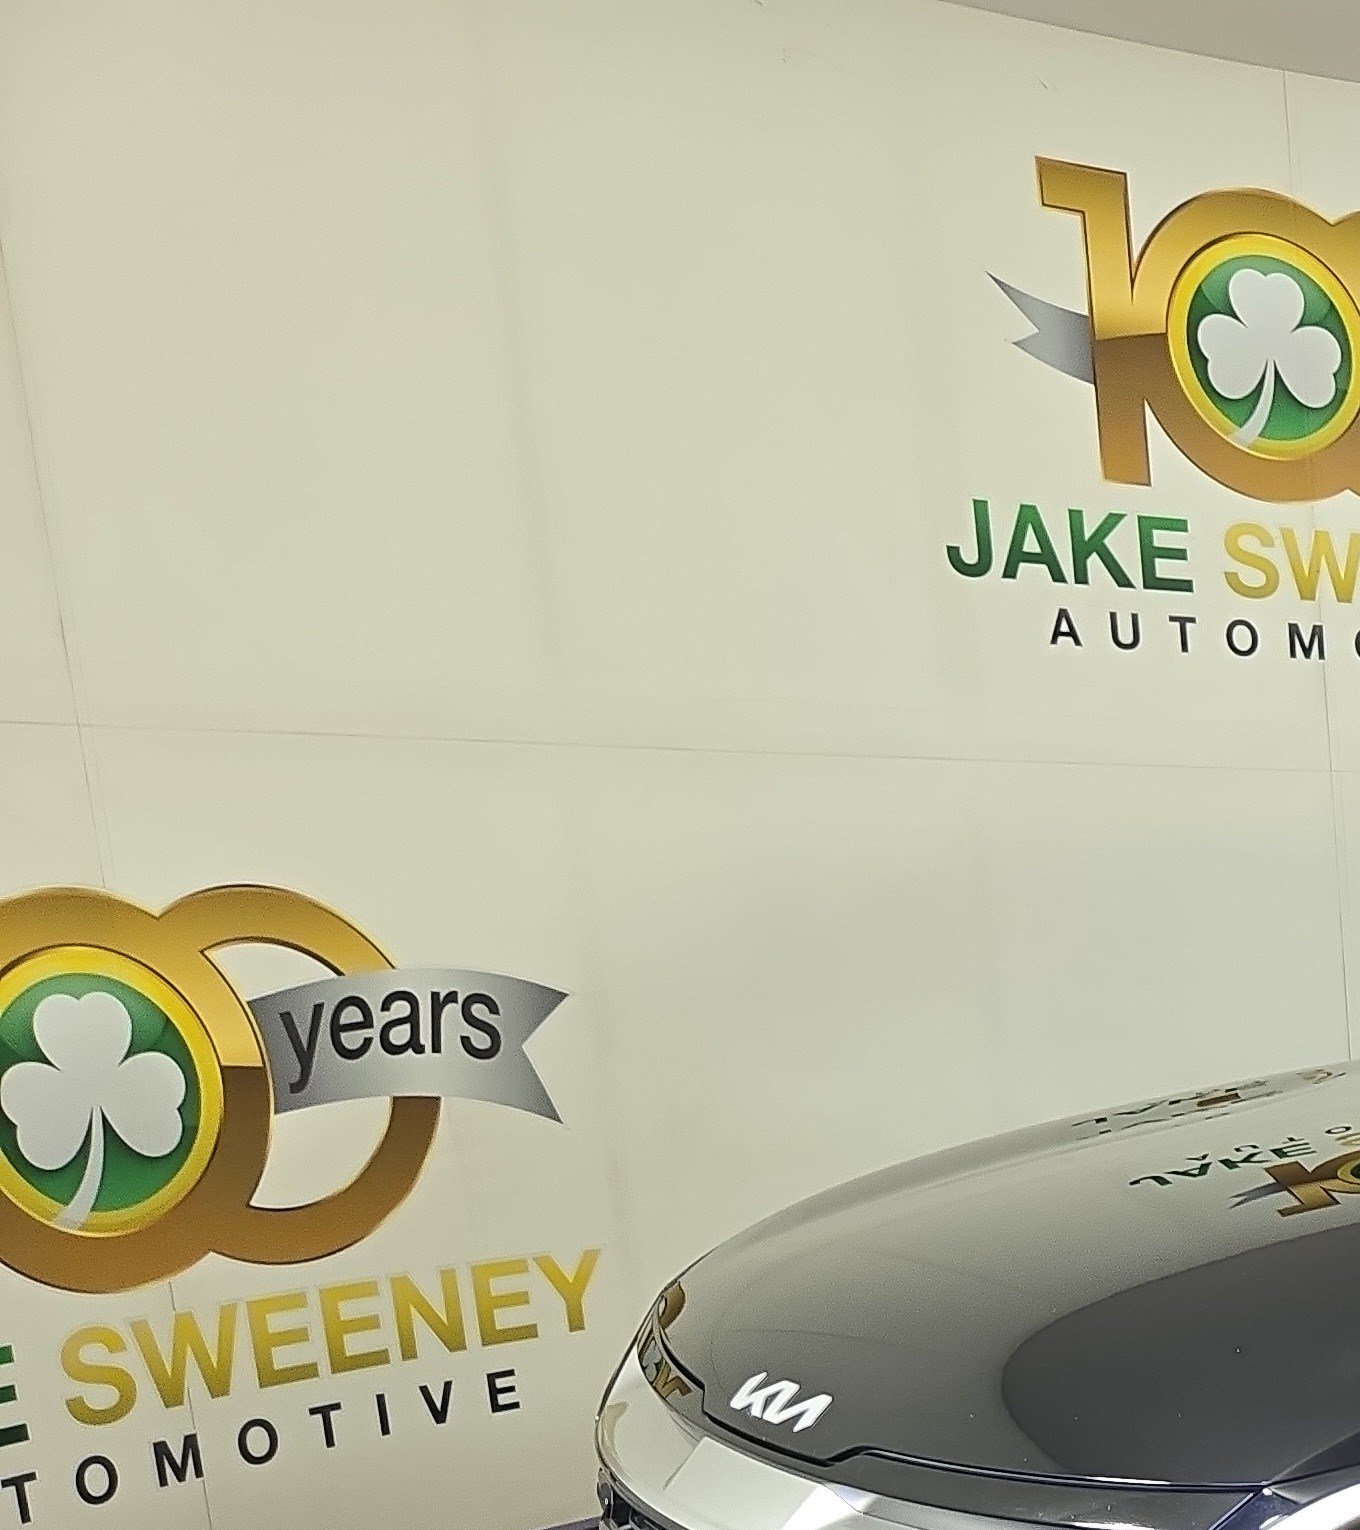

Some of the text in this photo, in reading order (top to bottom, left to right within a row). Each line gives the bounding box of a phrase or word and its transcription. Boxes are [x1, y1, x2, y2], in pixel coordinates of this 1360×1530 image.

[945, 497, 1195, 593] JAKE
[278, 984, 505, 1096] years
[59, 1248, 603, 1428] SWEENEY
[729, 1371, 833, 1433] KIA
